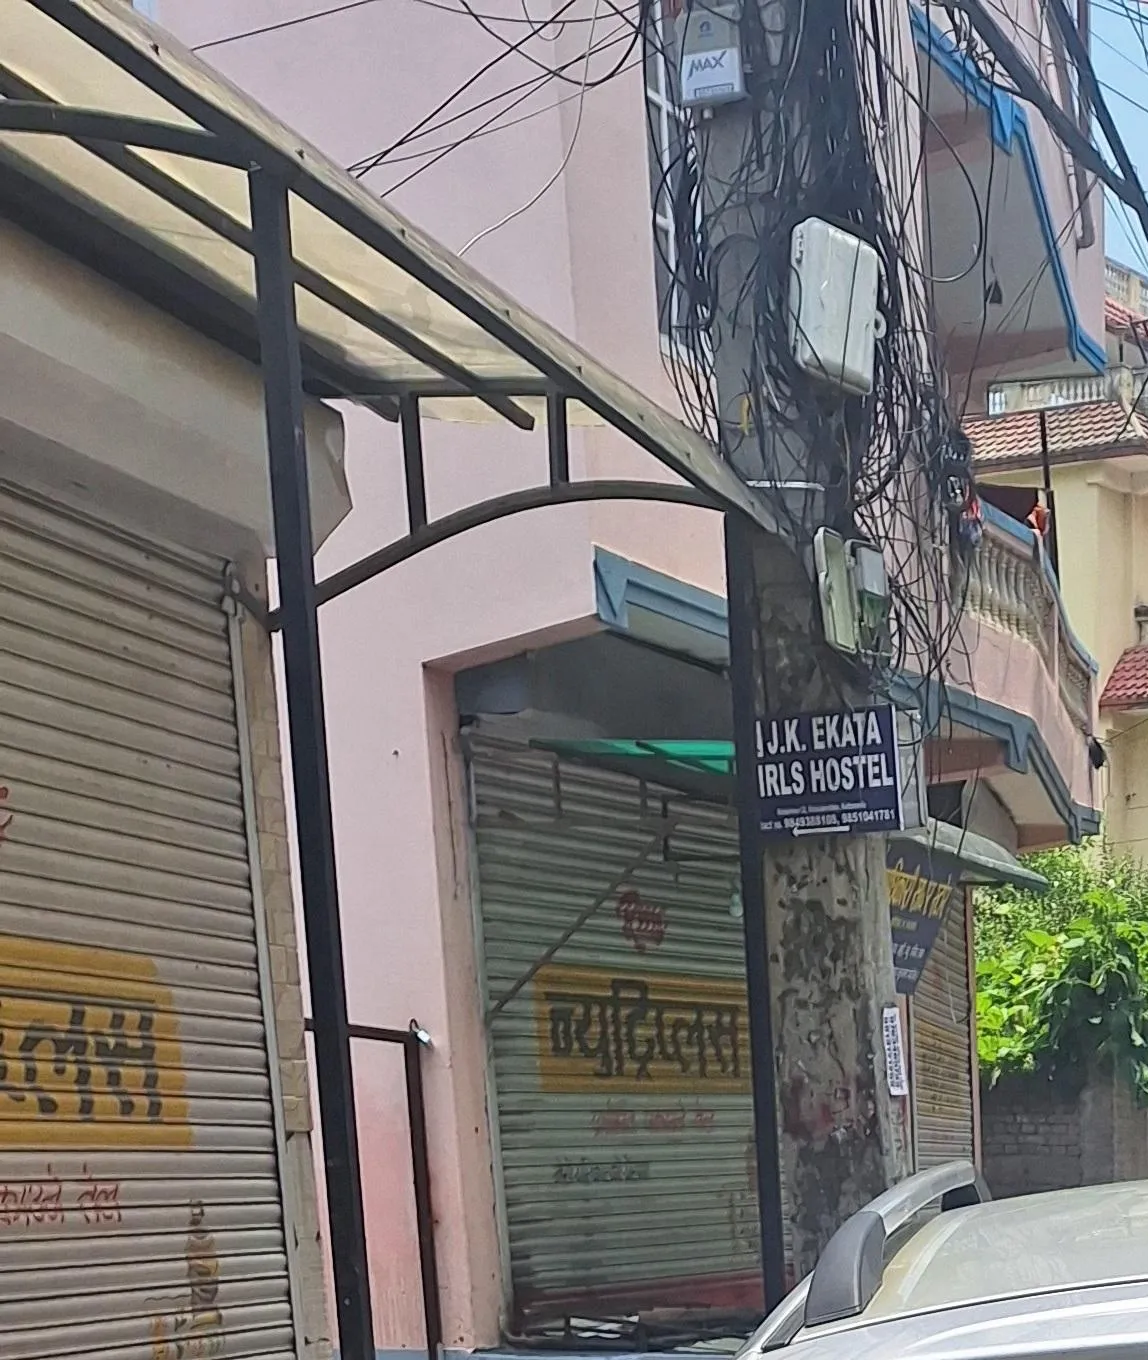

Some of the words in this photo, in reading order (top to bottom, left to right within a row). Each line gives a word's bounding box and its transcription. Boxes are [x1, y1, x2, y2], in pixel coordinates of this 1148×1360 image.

[687, 50, 727, 80] MAX
[812, 711, 882, 750] EKATA
[758, 761, 805, 797] IRLS
[810, 753, 894, 793] HOSTEL
